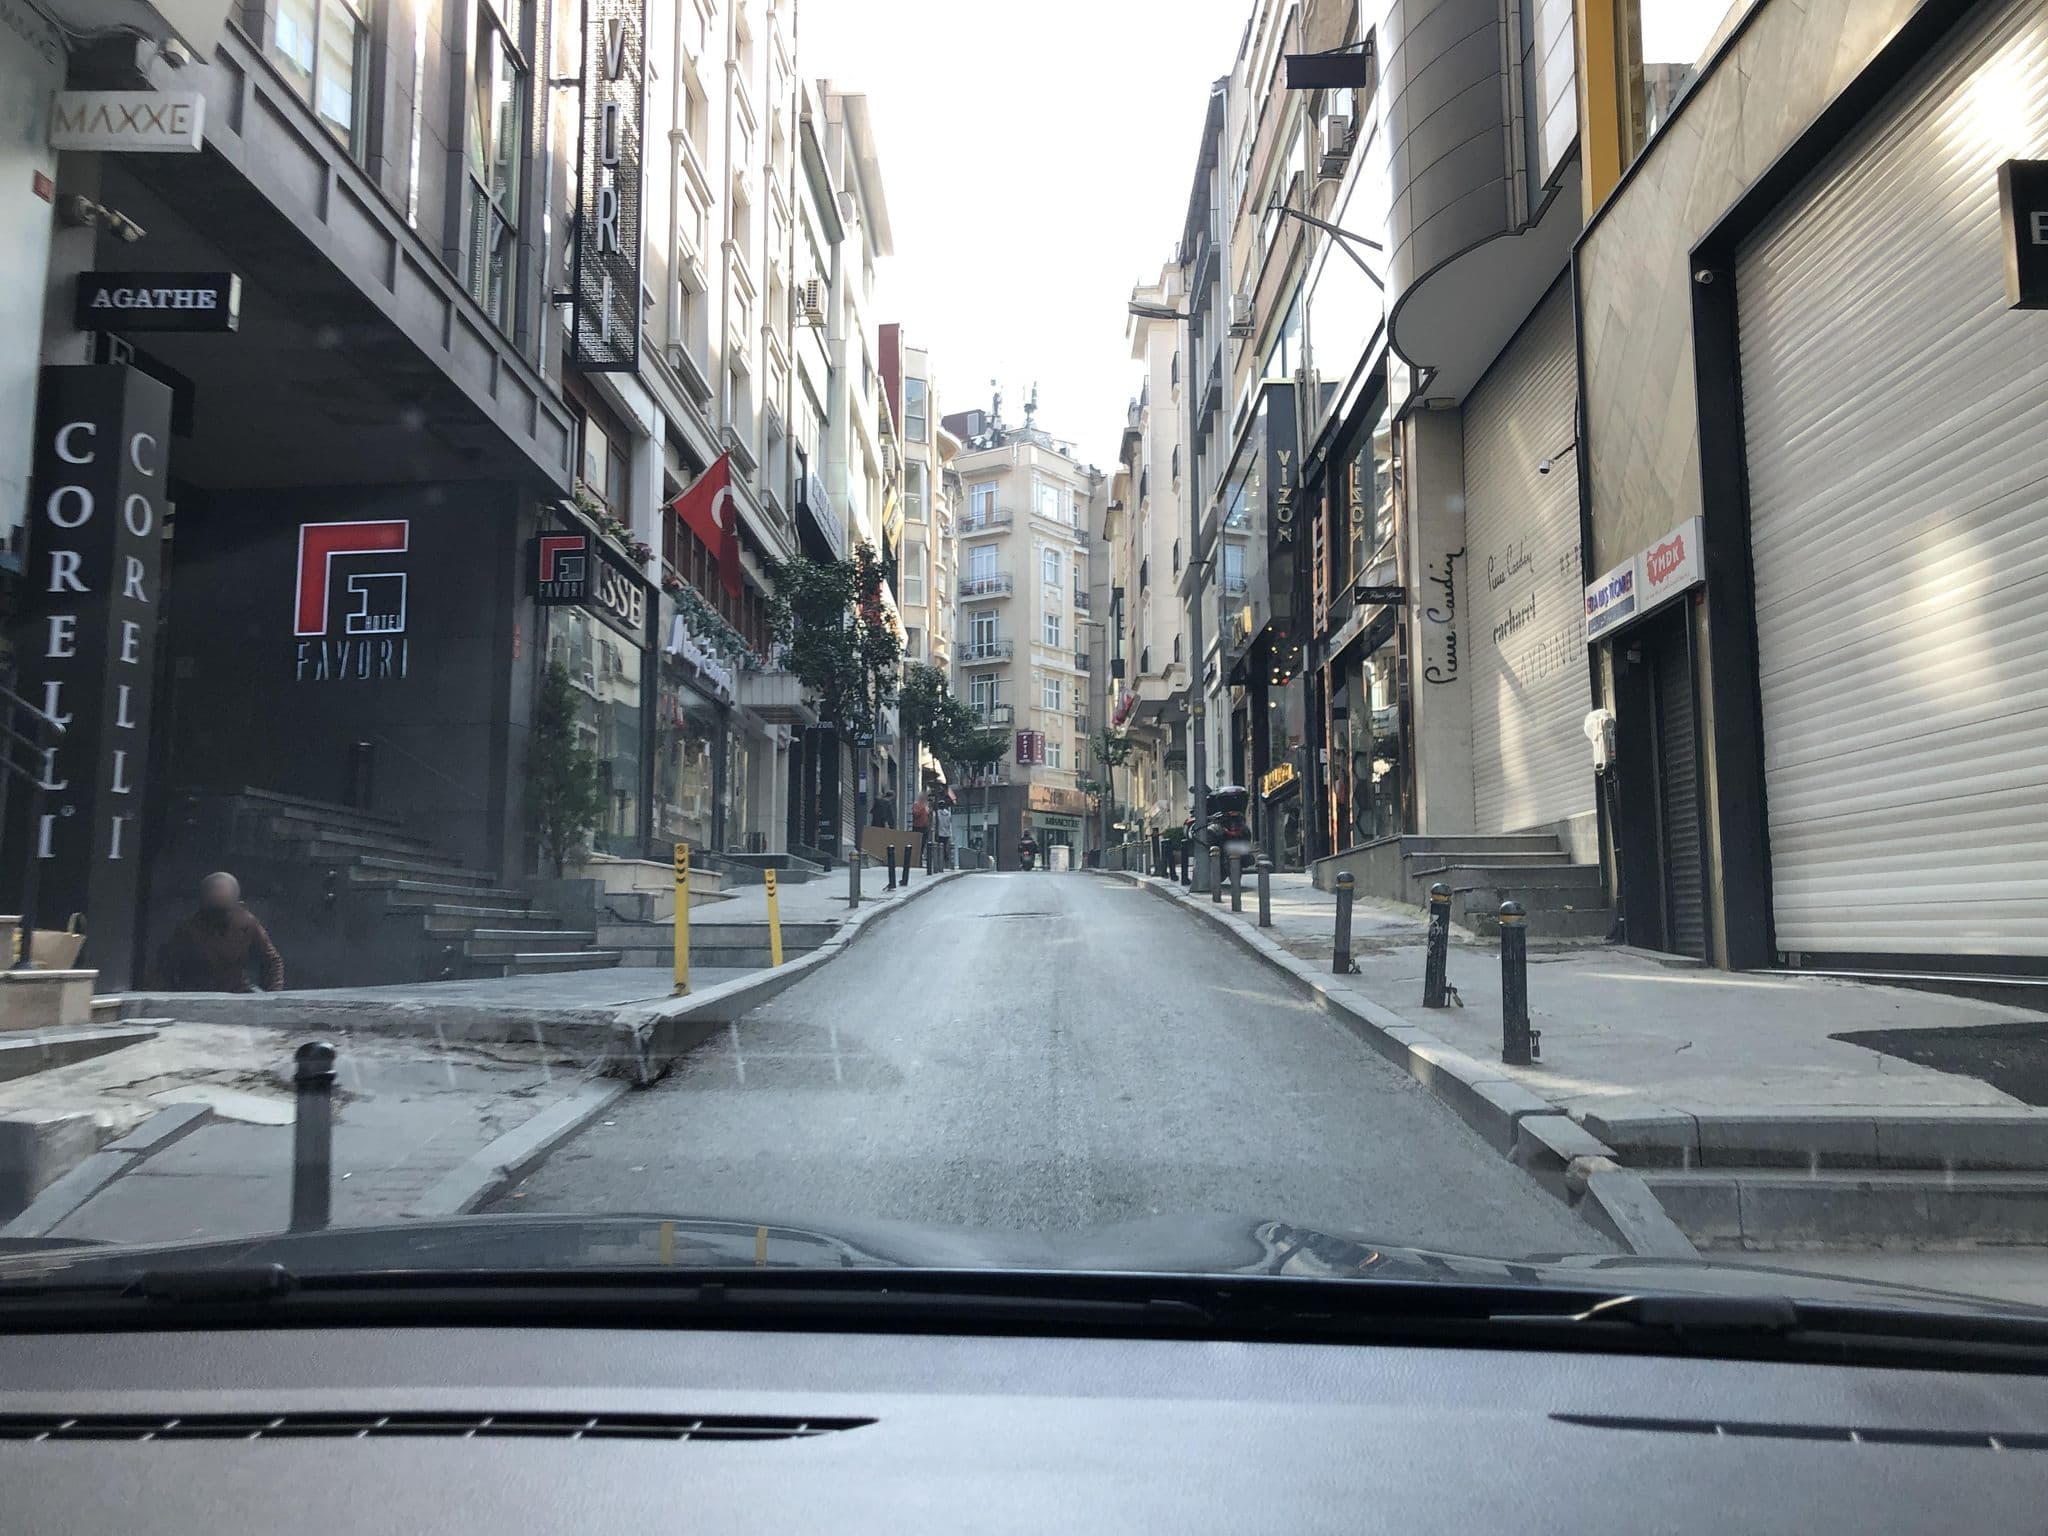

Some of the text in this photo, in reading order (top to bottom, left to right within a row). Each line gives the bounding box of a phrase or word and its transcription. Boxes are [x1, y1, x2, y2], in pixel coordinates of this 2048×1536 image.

[91, 288, 218, 310] AGATHE
[38, 422, 97, 858] CORELLI
[108, 432, 157, 858] CORELLI
[295, 638, 408, 681] FAVORI
[364, 614, 402, 631] HOTEL
[1425, 546, 1465, 685] Pierre Cardin
